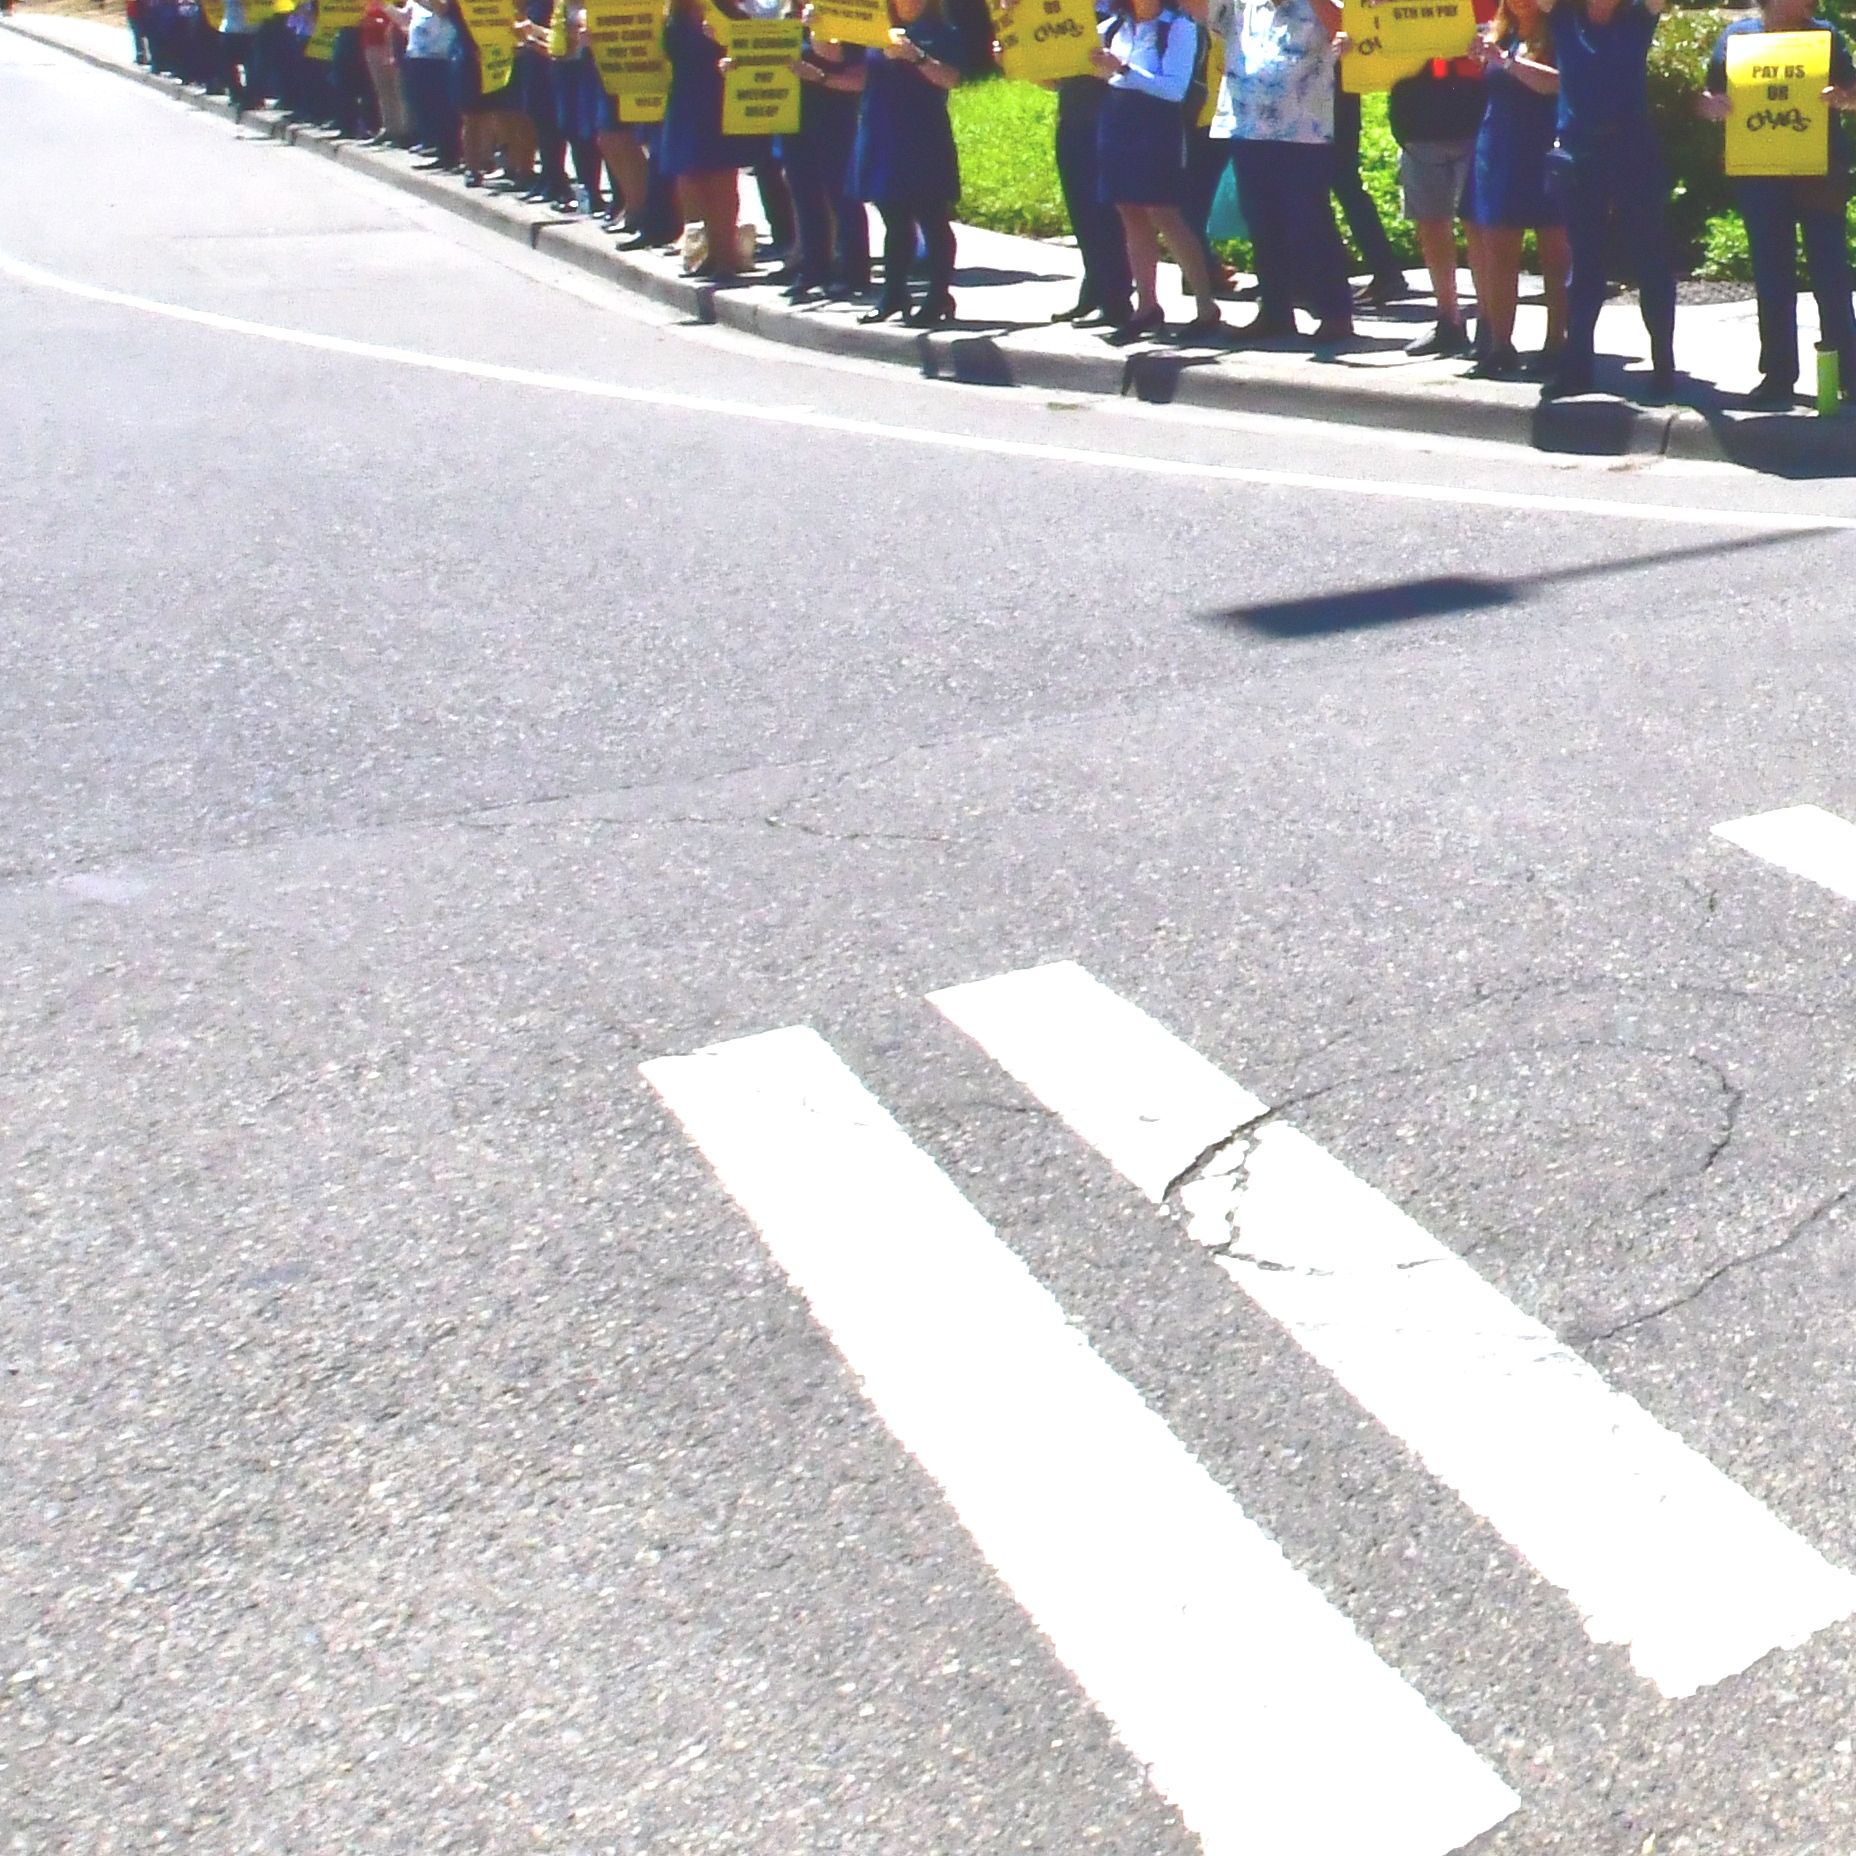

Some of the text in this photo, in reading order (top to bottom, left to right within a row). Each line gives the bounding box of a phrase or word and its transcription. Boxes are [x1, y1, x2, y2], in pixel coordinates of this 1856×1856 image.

[1421, 7, 1434, 18] IN
[1437, 5, 1459, 18] PAY
[1752, 64, 1806, 79] PAY US
[1767, 85, 1789, 101] OR
[1746, 107, 1812, 133] CHAOS
